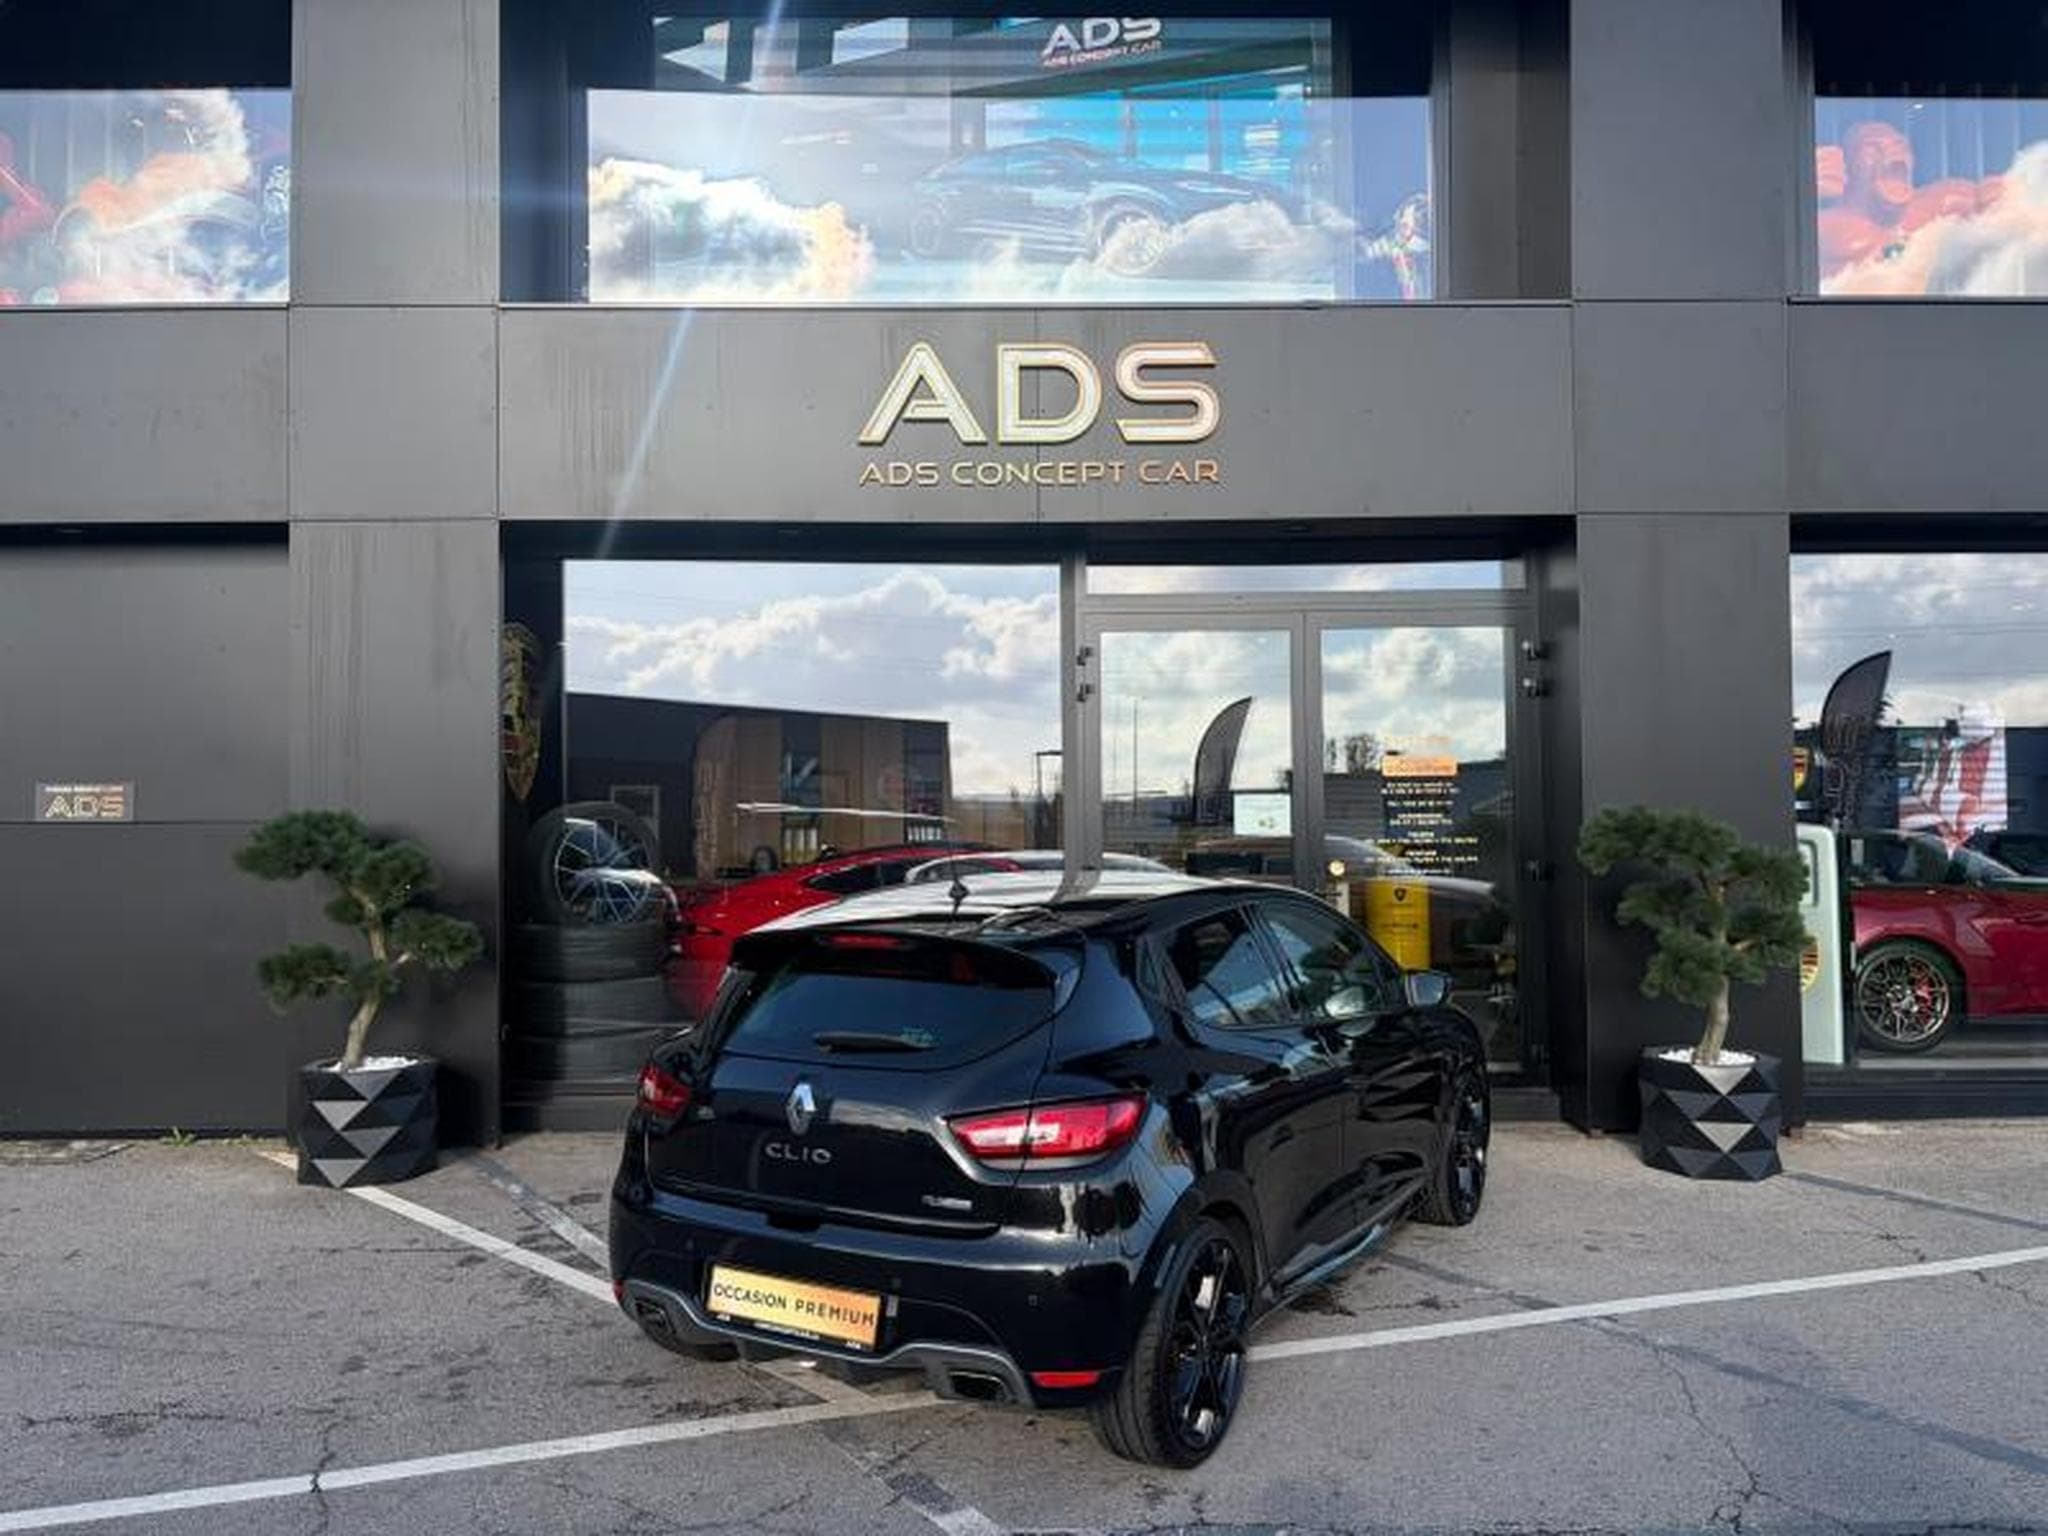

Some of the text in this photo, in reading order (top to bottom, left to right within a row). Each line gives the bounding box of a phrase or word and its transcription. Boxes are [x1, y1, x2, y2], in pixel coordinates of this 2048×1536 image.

[1041, 17, 1161, 56] ADS
[858, 341, 1220, 443] ADS
[859, 460, 1220, 485] ADS CONCEPT CAR
[45, 795, 123, 818] ADS
[765, 1143, 832, 1164] CLIO
[713, 1284, 874, 1326] OCCASION PREMIUM
